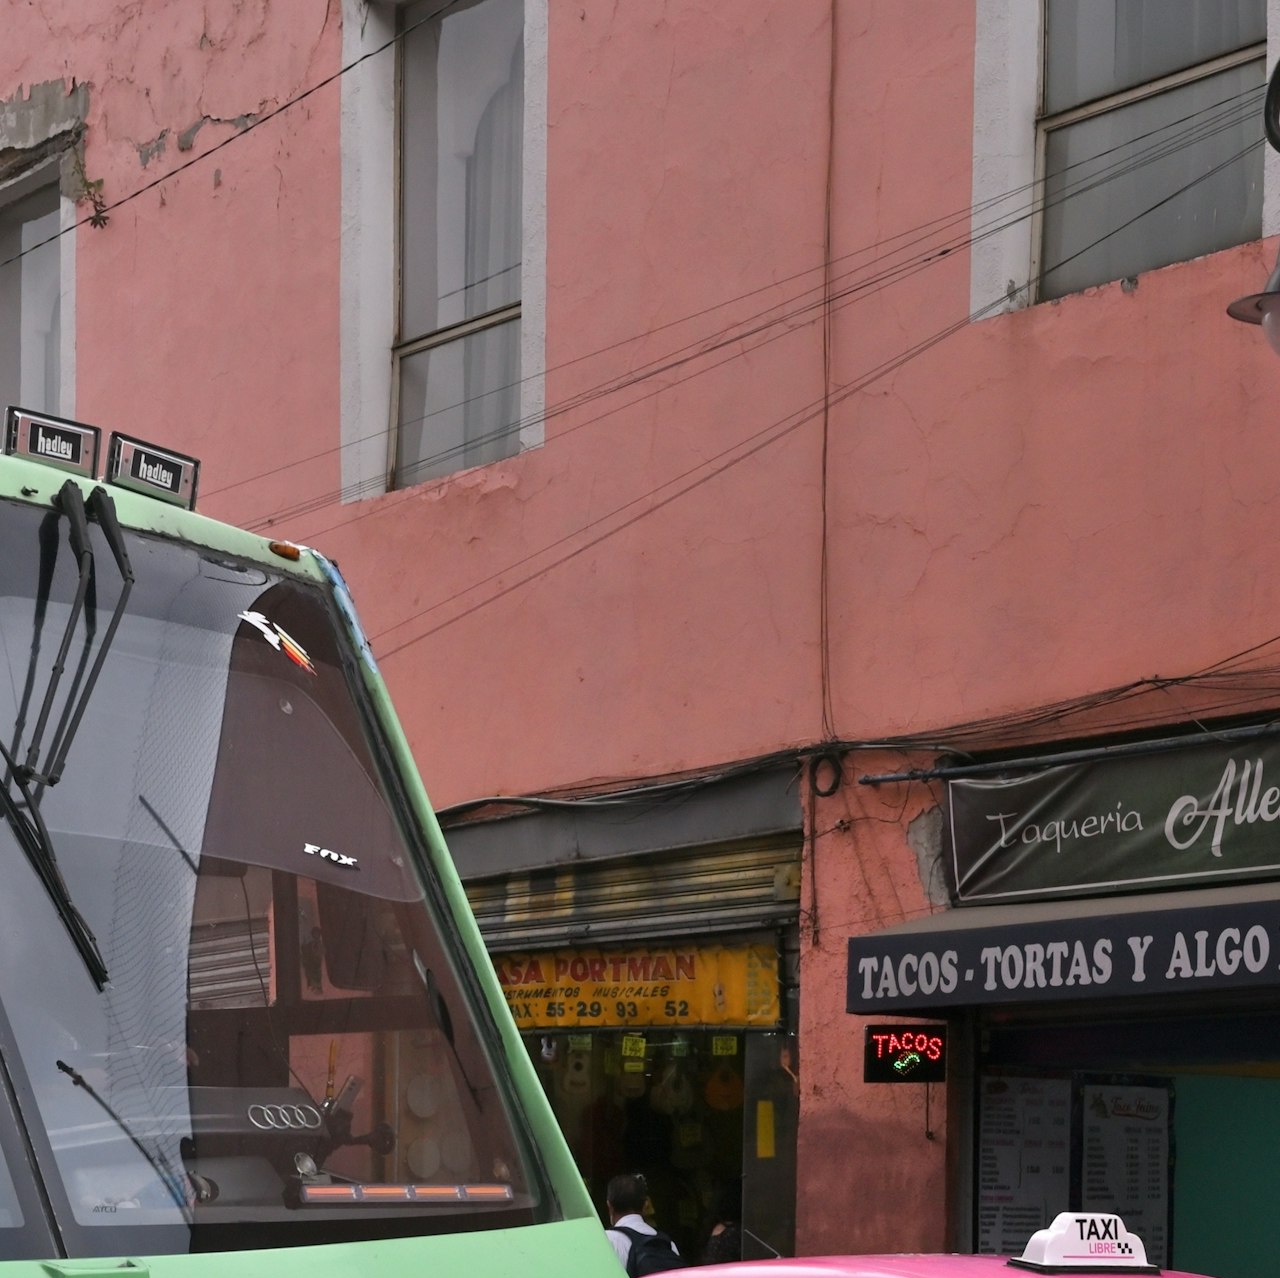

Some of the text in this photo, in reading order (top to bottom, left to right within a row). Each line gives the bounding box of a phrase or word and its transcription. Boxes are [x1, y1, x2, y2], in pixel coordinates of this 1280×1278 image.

[38, 427, 72, 459] hadley
[139, 454, 173, 488] hadley
[497, 953, 696, 986] ASA PORTMAN
[858, 949, 959, 999] TACOS
[981, 938, 1114, 992] TORTAS
[1127, 935, 1154, 983] Y
[1166, 924, 1270, 980] ALGO
[592, 985, 670, 999] MUSICALES
[872, 1031, 942, 1060] TACOS
[1075, 1218, 1119, 1240] TAXI
[1089, 1242, 1116, 1254] LIBRE
